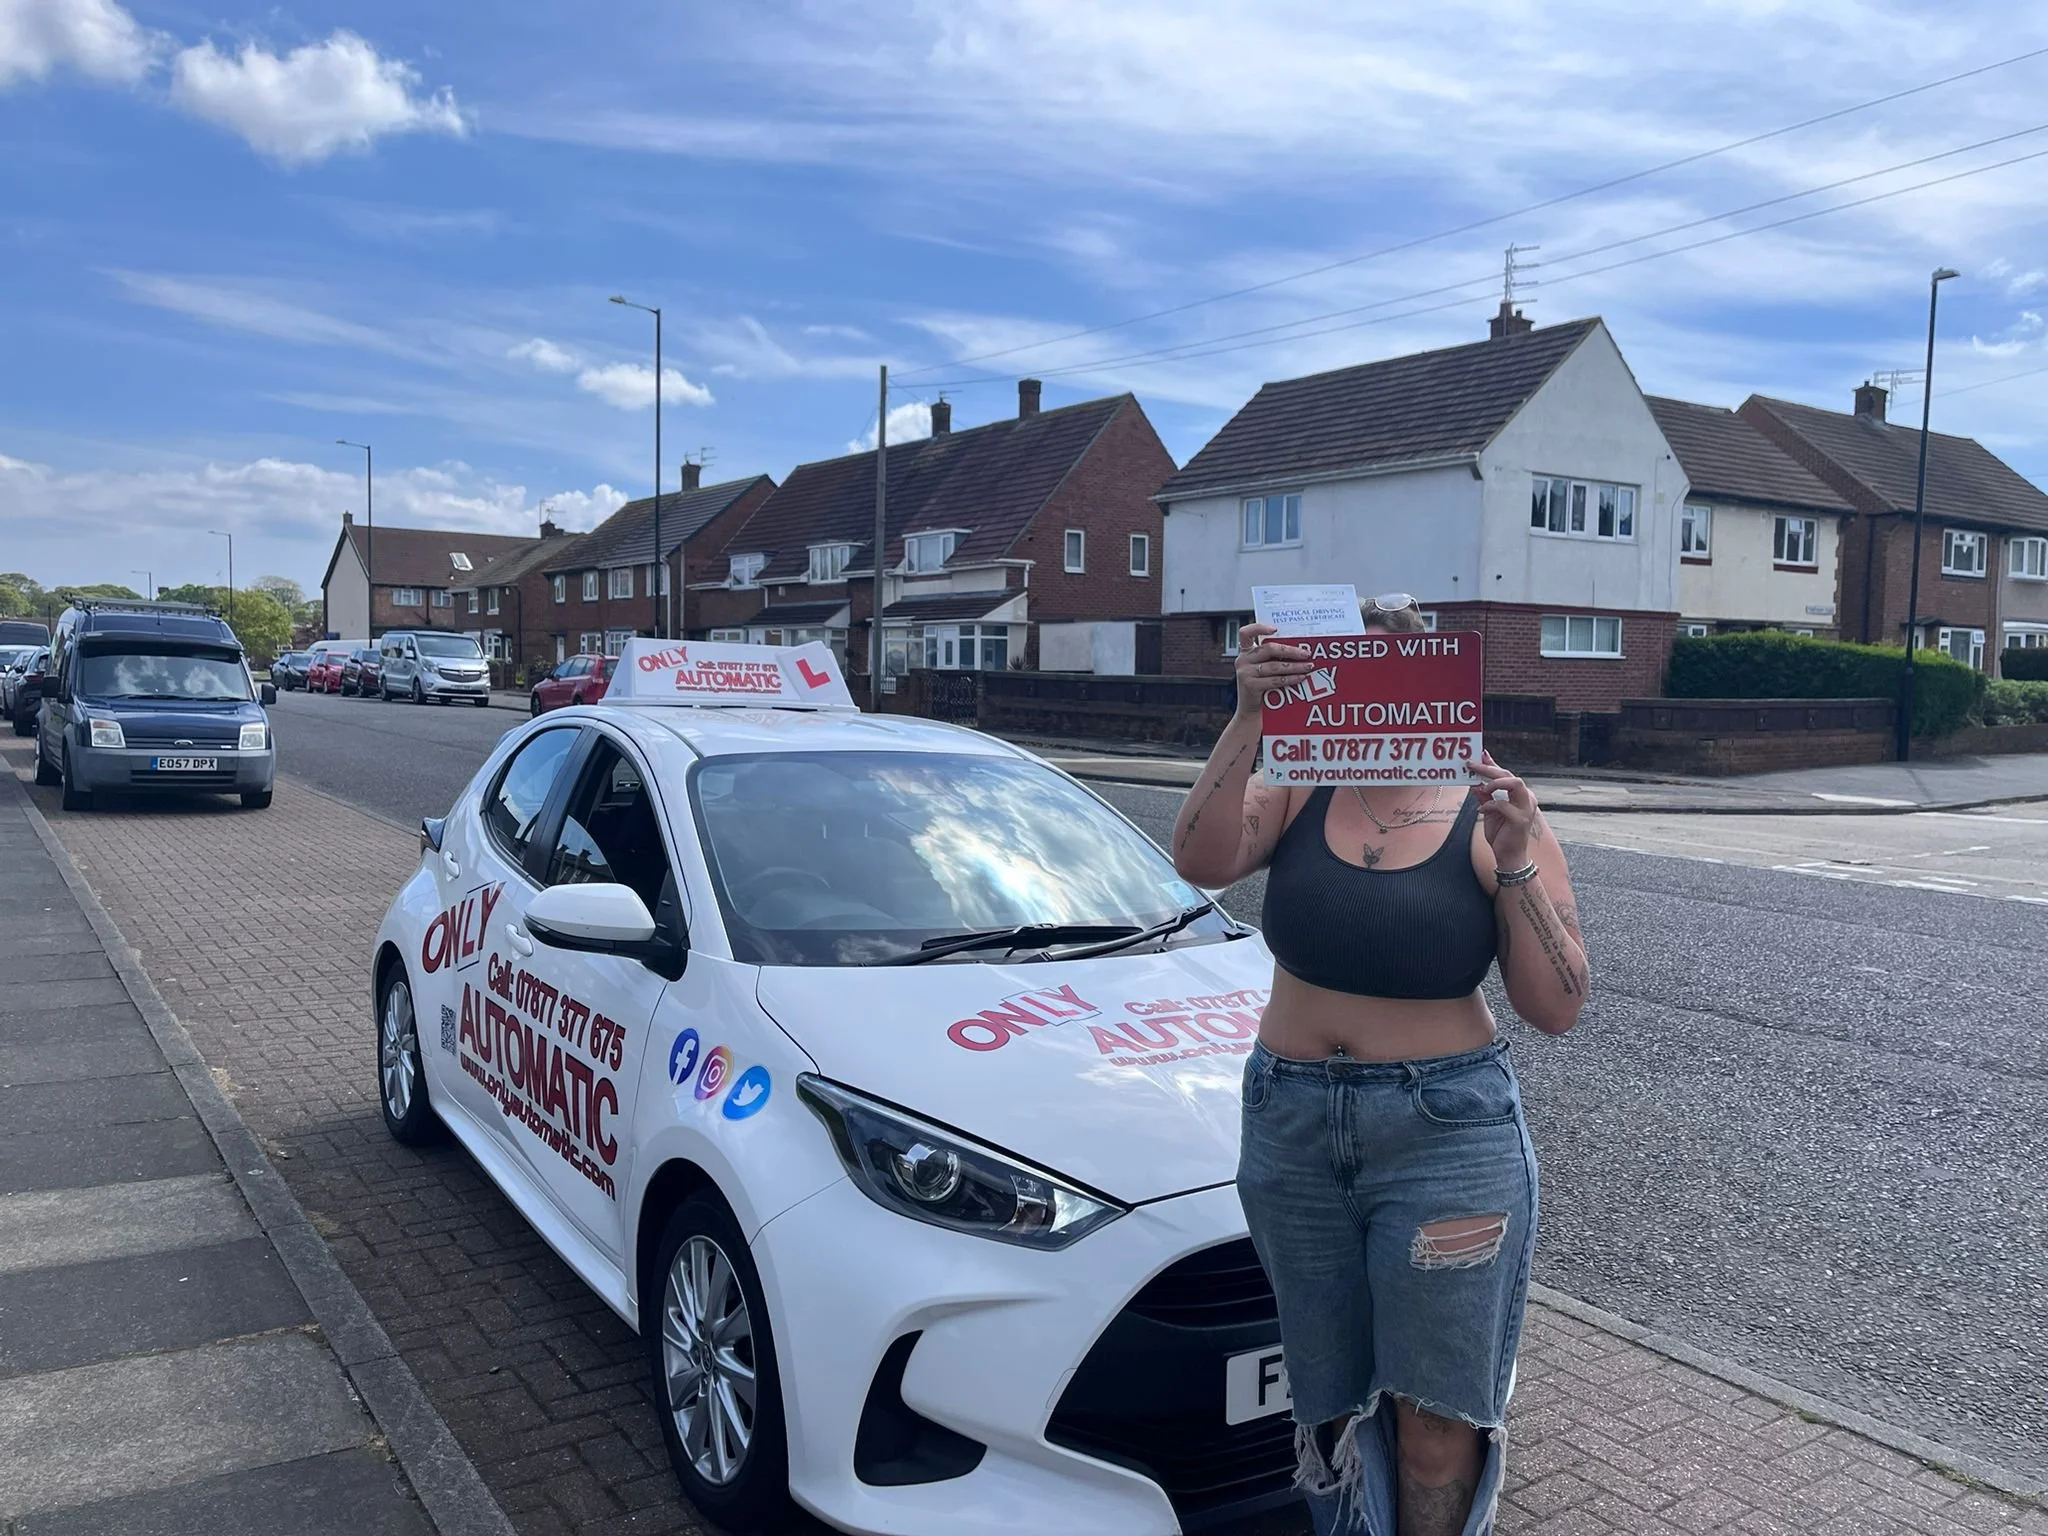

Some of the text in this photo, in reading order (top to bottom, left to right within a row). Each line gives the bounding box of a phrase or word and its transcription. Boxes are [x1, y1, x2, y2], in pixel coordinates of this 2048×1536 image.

[638, 646, 688, 672] ONLY
[1396, 637, 1459, 657] WITH
[675, 669, 782, 689] AUTOMATIC
[795, 658, 831, 689] L
[1263, 666, 1338, 710] ONLY
[1305, 701, 1477, 728] AUTOMATIC
[1271, 737, 1473, 762] Call: 07877 377 675
[192, 758, 216, 769] DPX
[1288, 766, 1456, 783] onlyautomatic.com
[422, 881, 507, 974] ONLY
[488, 952, 626, 1072] Call: 07877 377 675
[1124, 989, 1266, 1015] Call: 07877
[946, 984, 1098, 1052] ONLY
[459, 982, 619, 1166] AUTOMATIC
[460, 1052, 616, 1201] www.onlyautomatic.com
